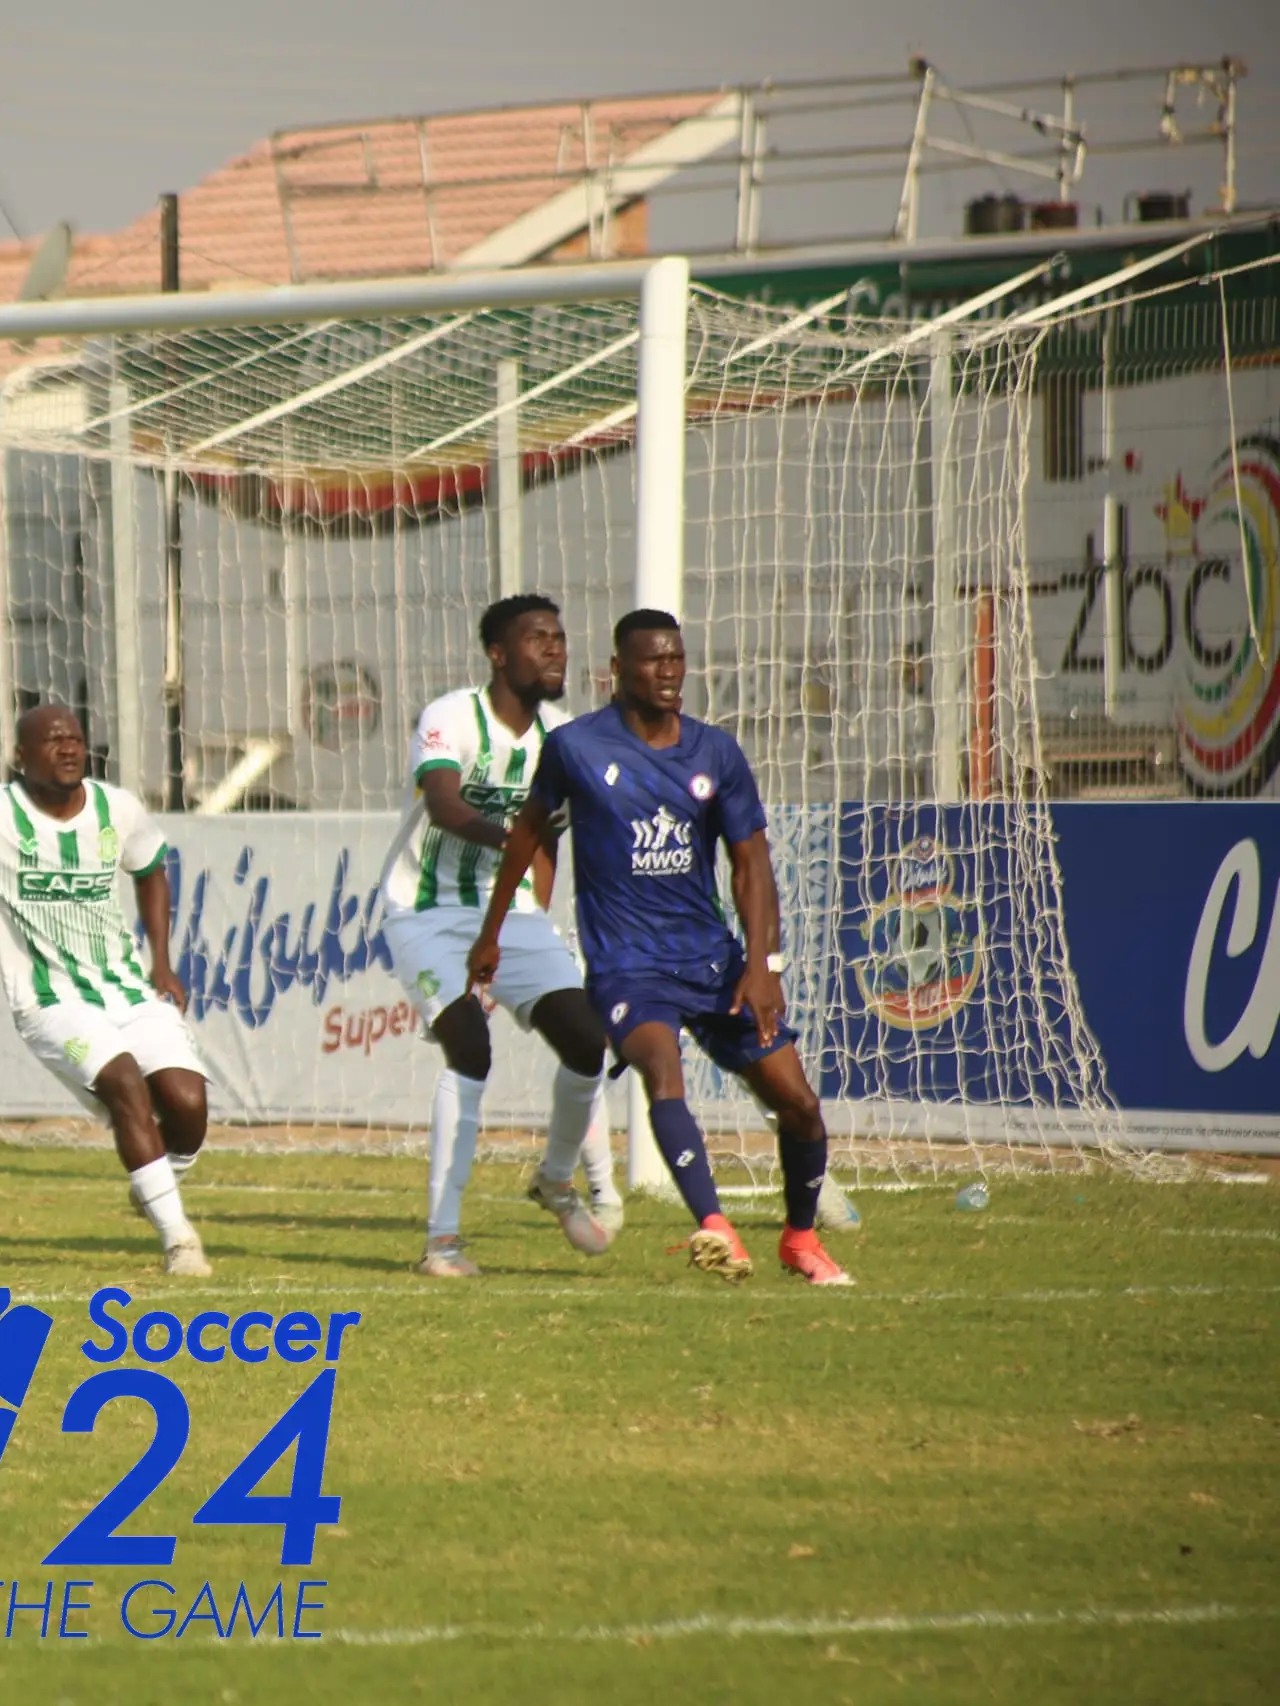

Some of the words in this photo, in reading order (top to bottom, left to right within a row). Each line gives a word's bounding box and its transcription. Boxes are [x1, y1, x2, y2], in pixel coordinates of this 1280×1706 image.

[1061, 504, 1233, 673] zbc
[464, 788, 531, 806] CAP
[631, 847, 694, 870] MWOS
[22, 873, 114, 894] CAPS
